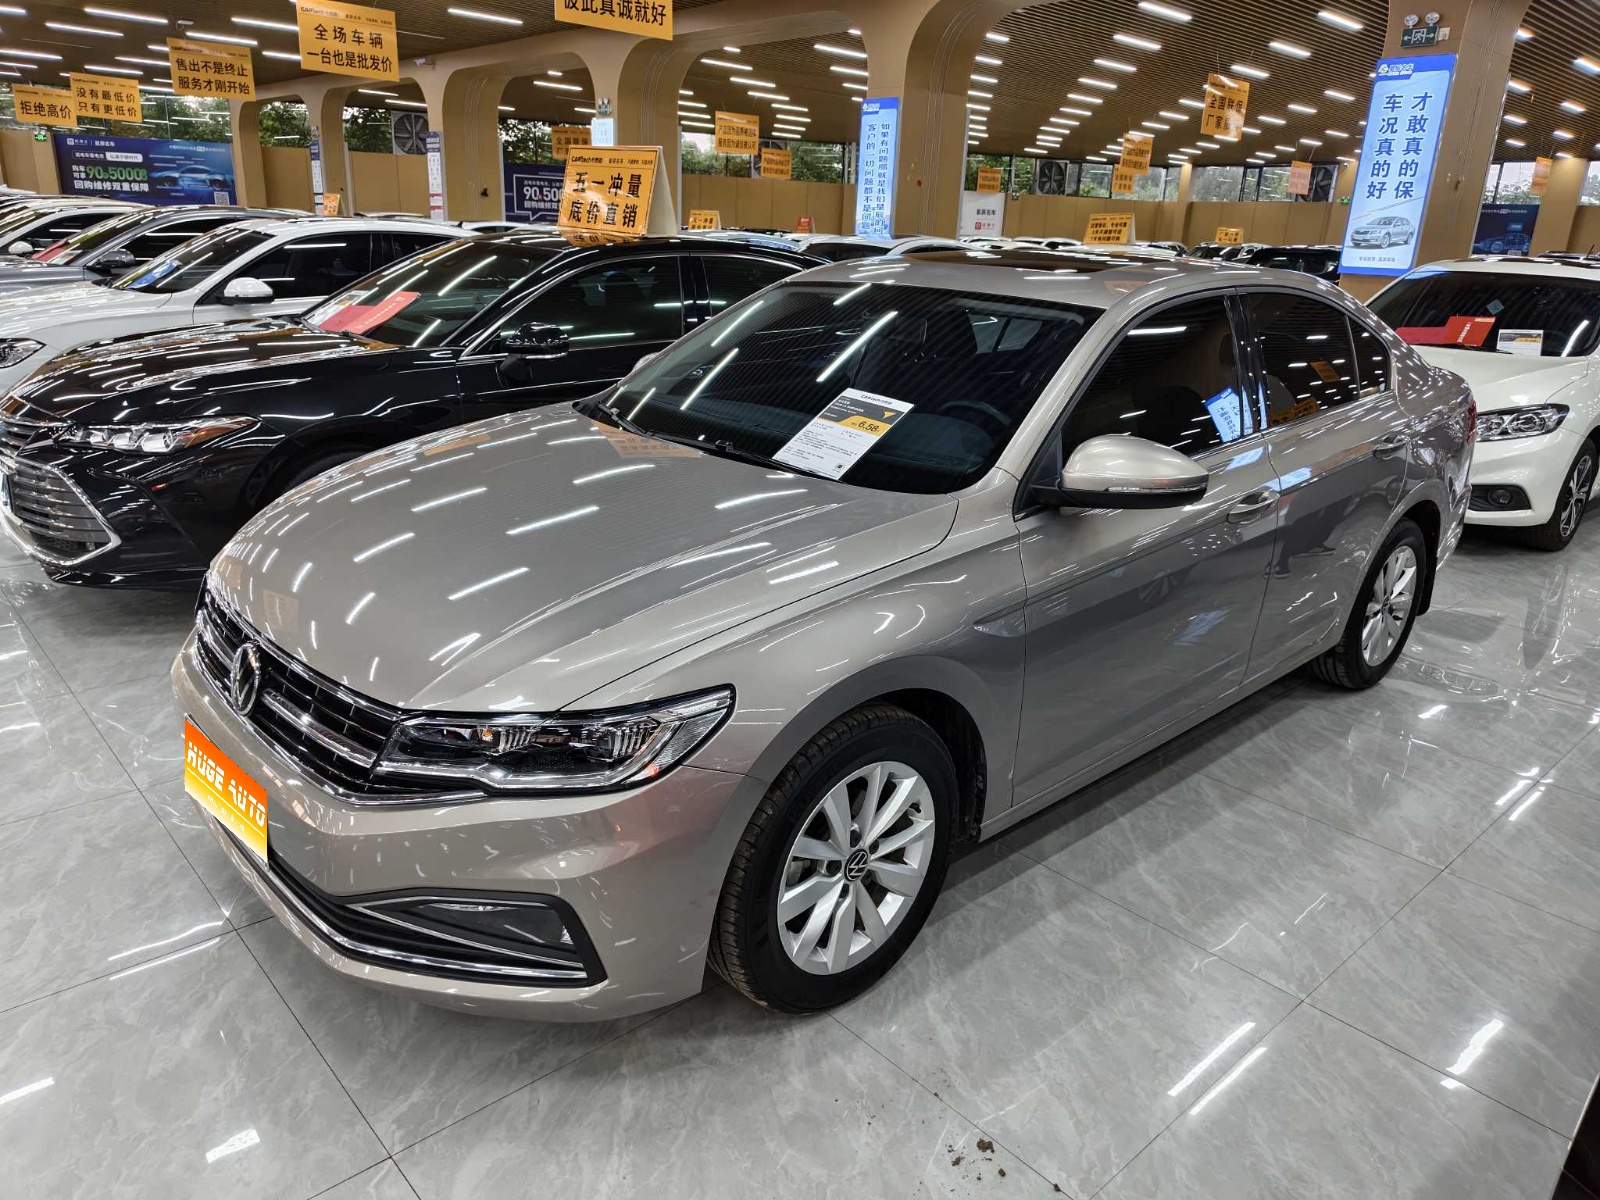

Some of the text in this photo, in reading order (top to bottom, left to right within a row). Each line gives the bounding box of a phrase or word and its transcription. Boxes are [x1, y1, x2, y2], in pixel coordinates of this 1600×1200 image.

[313, 23, 383, 50] 全场车辆
[176, 57, 248, 77] 售出不是终止
[307, 47, 392, 73] 一台也是批发价
[76, 87, 135, 103] 没有最低价
[178, 76, 250, 95] 服务才刚开始
[20, 99, 72, 120] 拒绝高价
[78, 101, 137, 117] 只有更低价
[1366, 93, 1404, 200] 车况真的好
[1394, 91, 1433, 200] 才敢真的保
[74, 180, 150, 192] 回购维修双重保障
[573, 172, 642, 198] 五一冲量
[861, 123, 877, 230] 客户的一切问题都不是问题
[568, 199, 638, 228] 底价直销
[858, 421, 878, 433] 6.58
